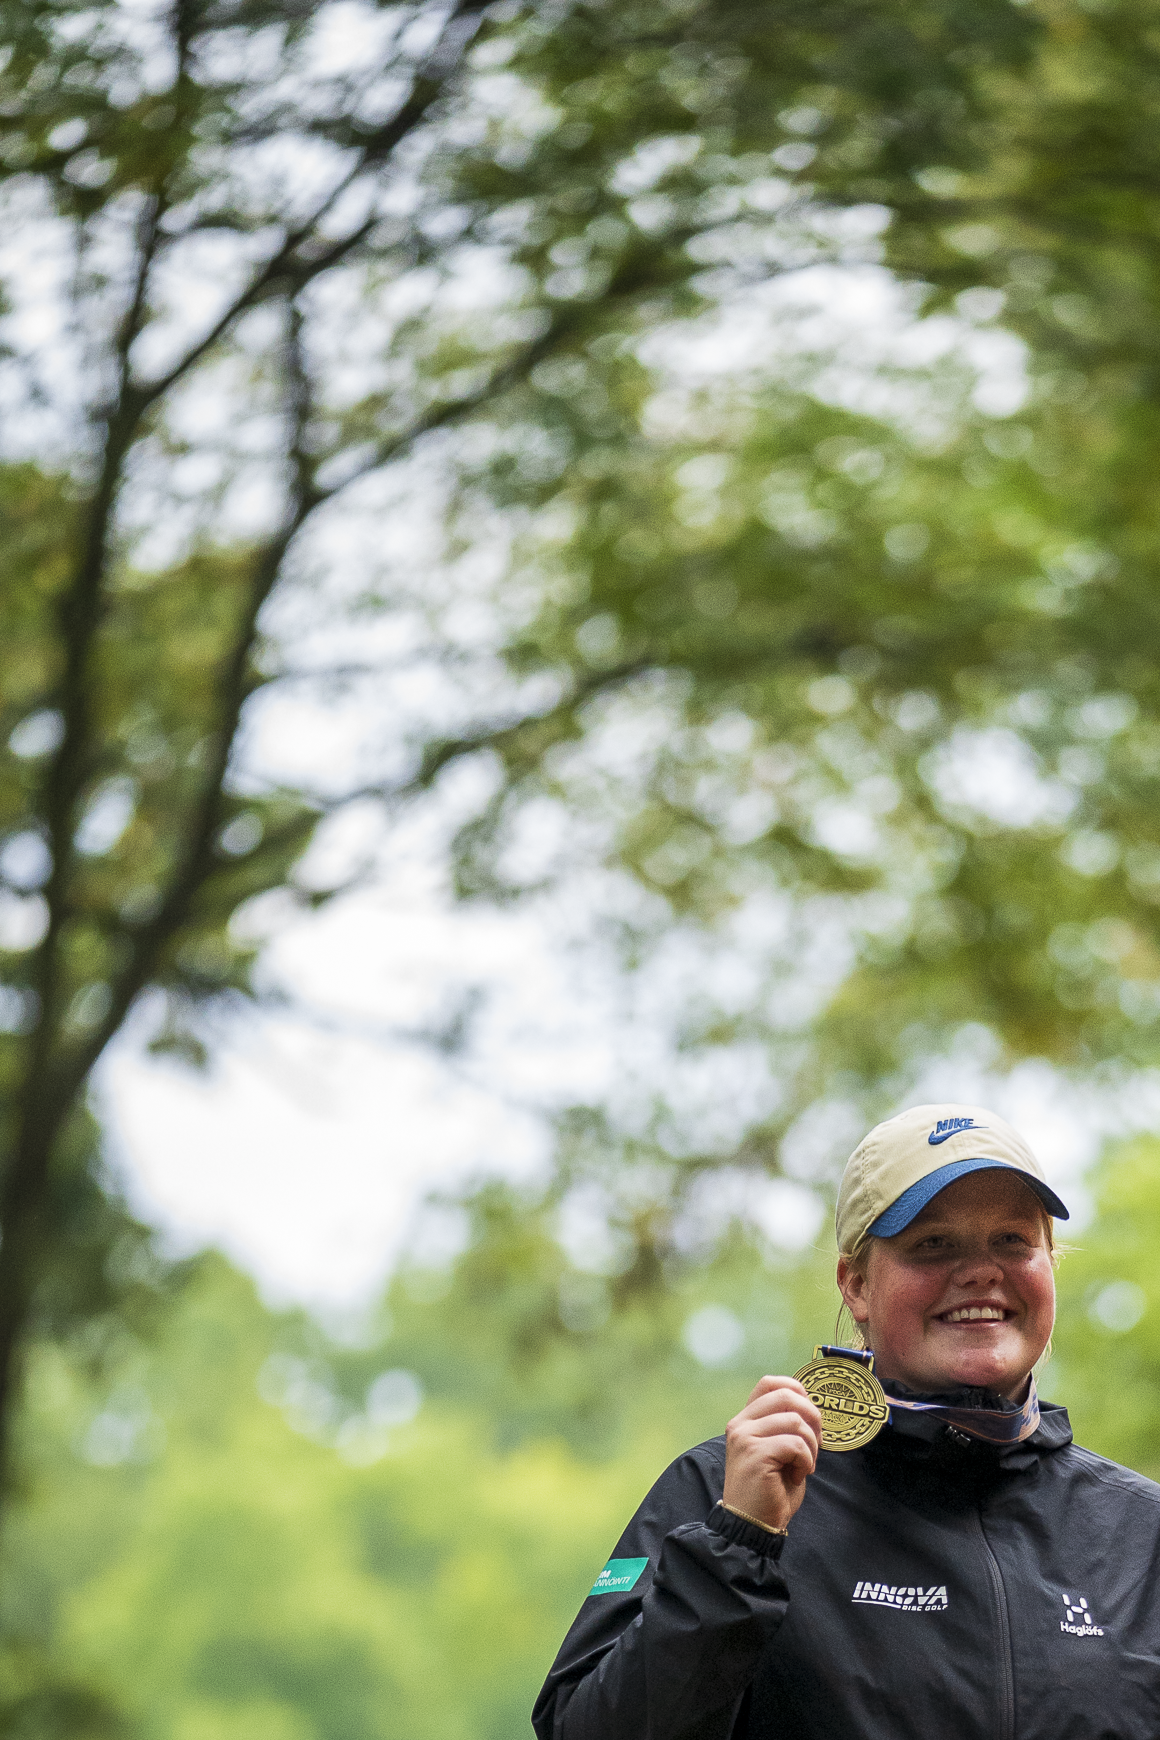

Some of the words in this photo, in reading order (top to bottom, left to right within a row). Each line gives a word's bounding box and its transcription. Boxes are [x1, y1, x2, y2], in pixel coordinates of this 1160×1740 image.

[936, 1118, 975, 1134] NIKE
[808, 1393, 885, 1419] ORLDS
[852, 1581, 949, 1605] INNOVA
[901, 1604, 923, 1612] DISC
[924, 1604, 949, 1612] GOLF
[1060, 1621, 1105, 1637] Haglöfs
